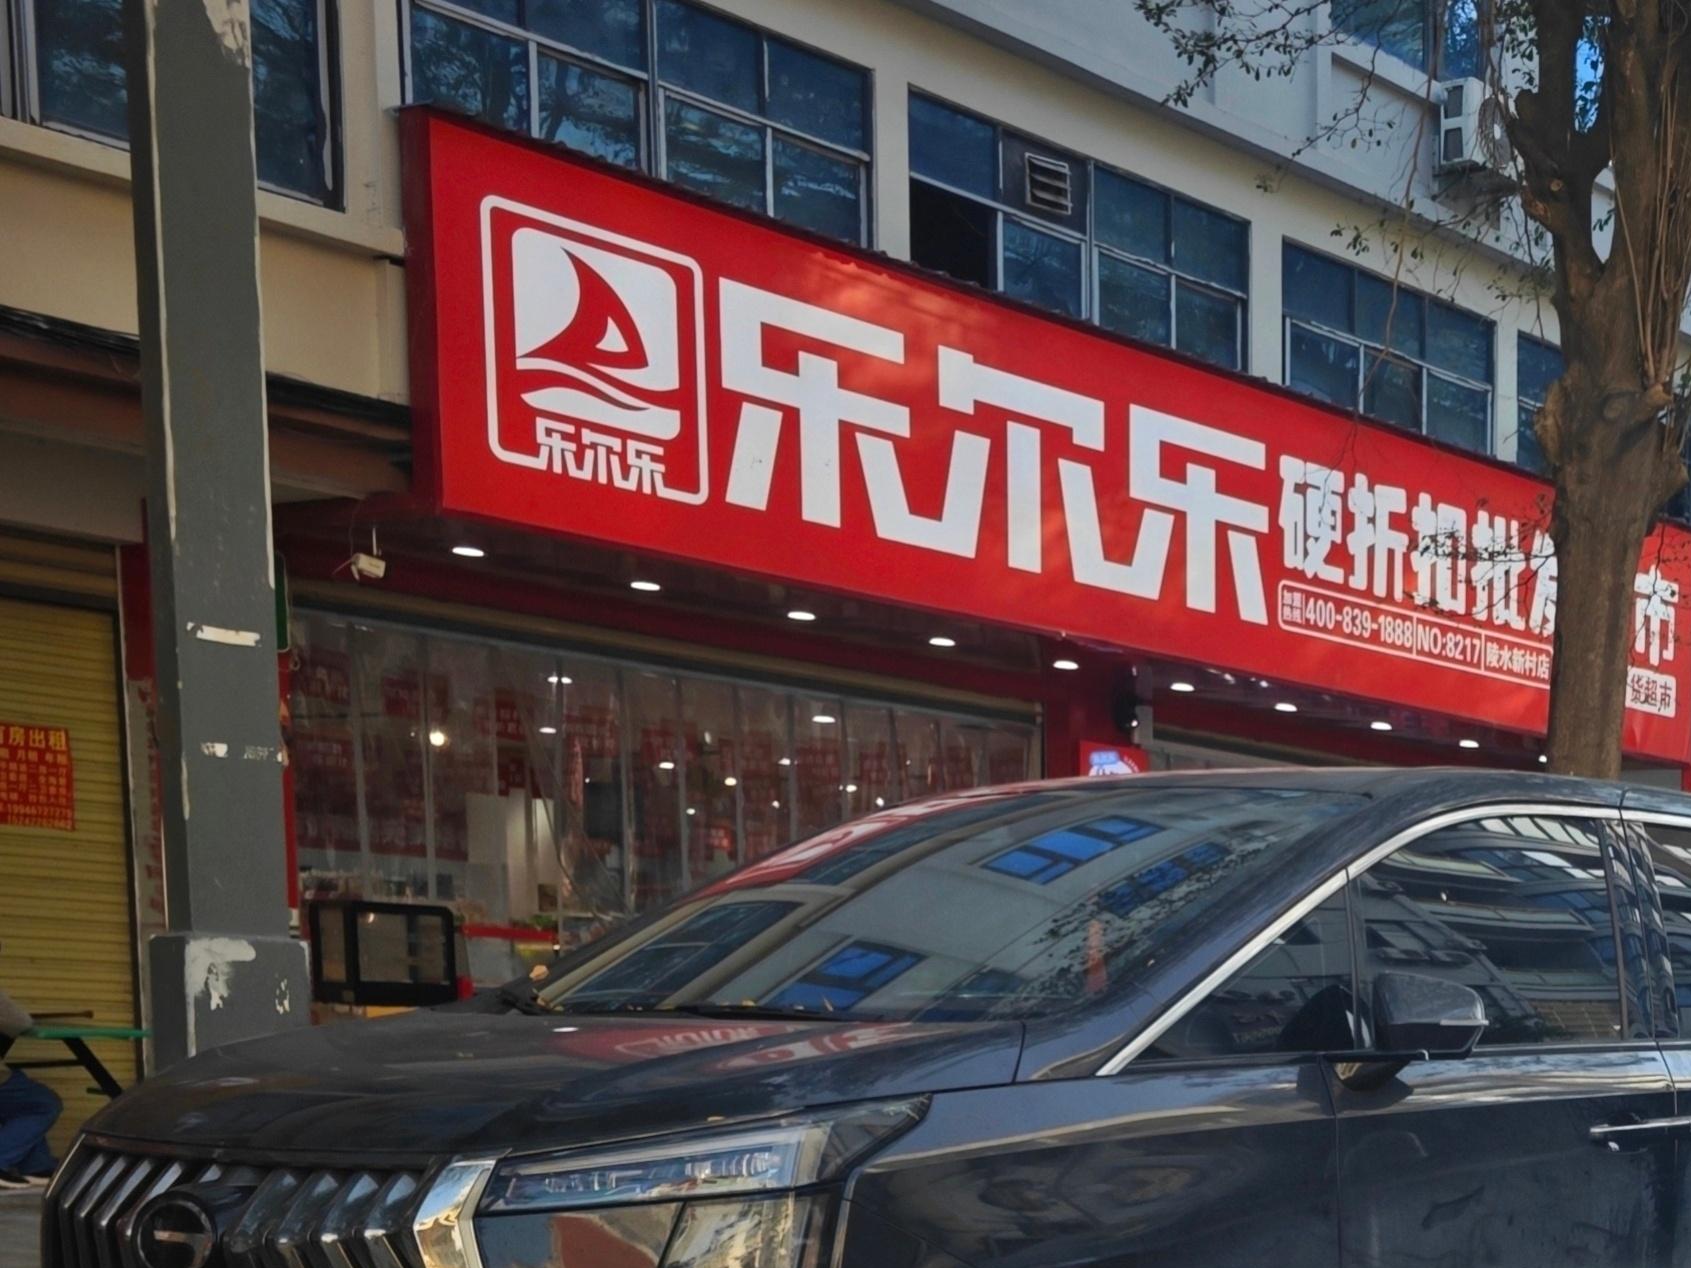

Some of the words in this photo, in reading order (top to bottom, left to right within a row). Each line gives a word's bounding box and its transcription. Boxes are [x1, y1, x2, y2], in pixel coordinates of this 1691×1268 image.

[1305, 597, 1413, 649] 400-839-1888
[1417, 621, 1482, 664] NO:8217
[1486, 641, 1550, 681] 陵水新村店
[0, 725, 67, 751] 房出租
